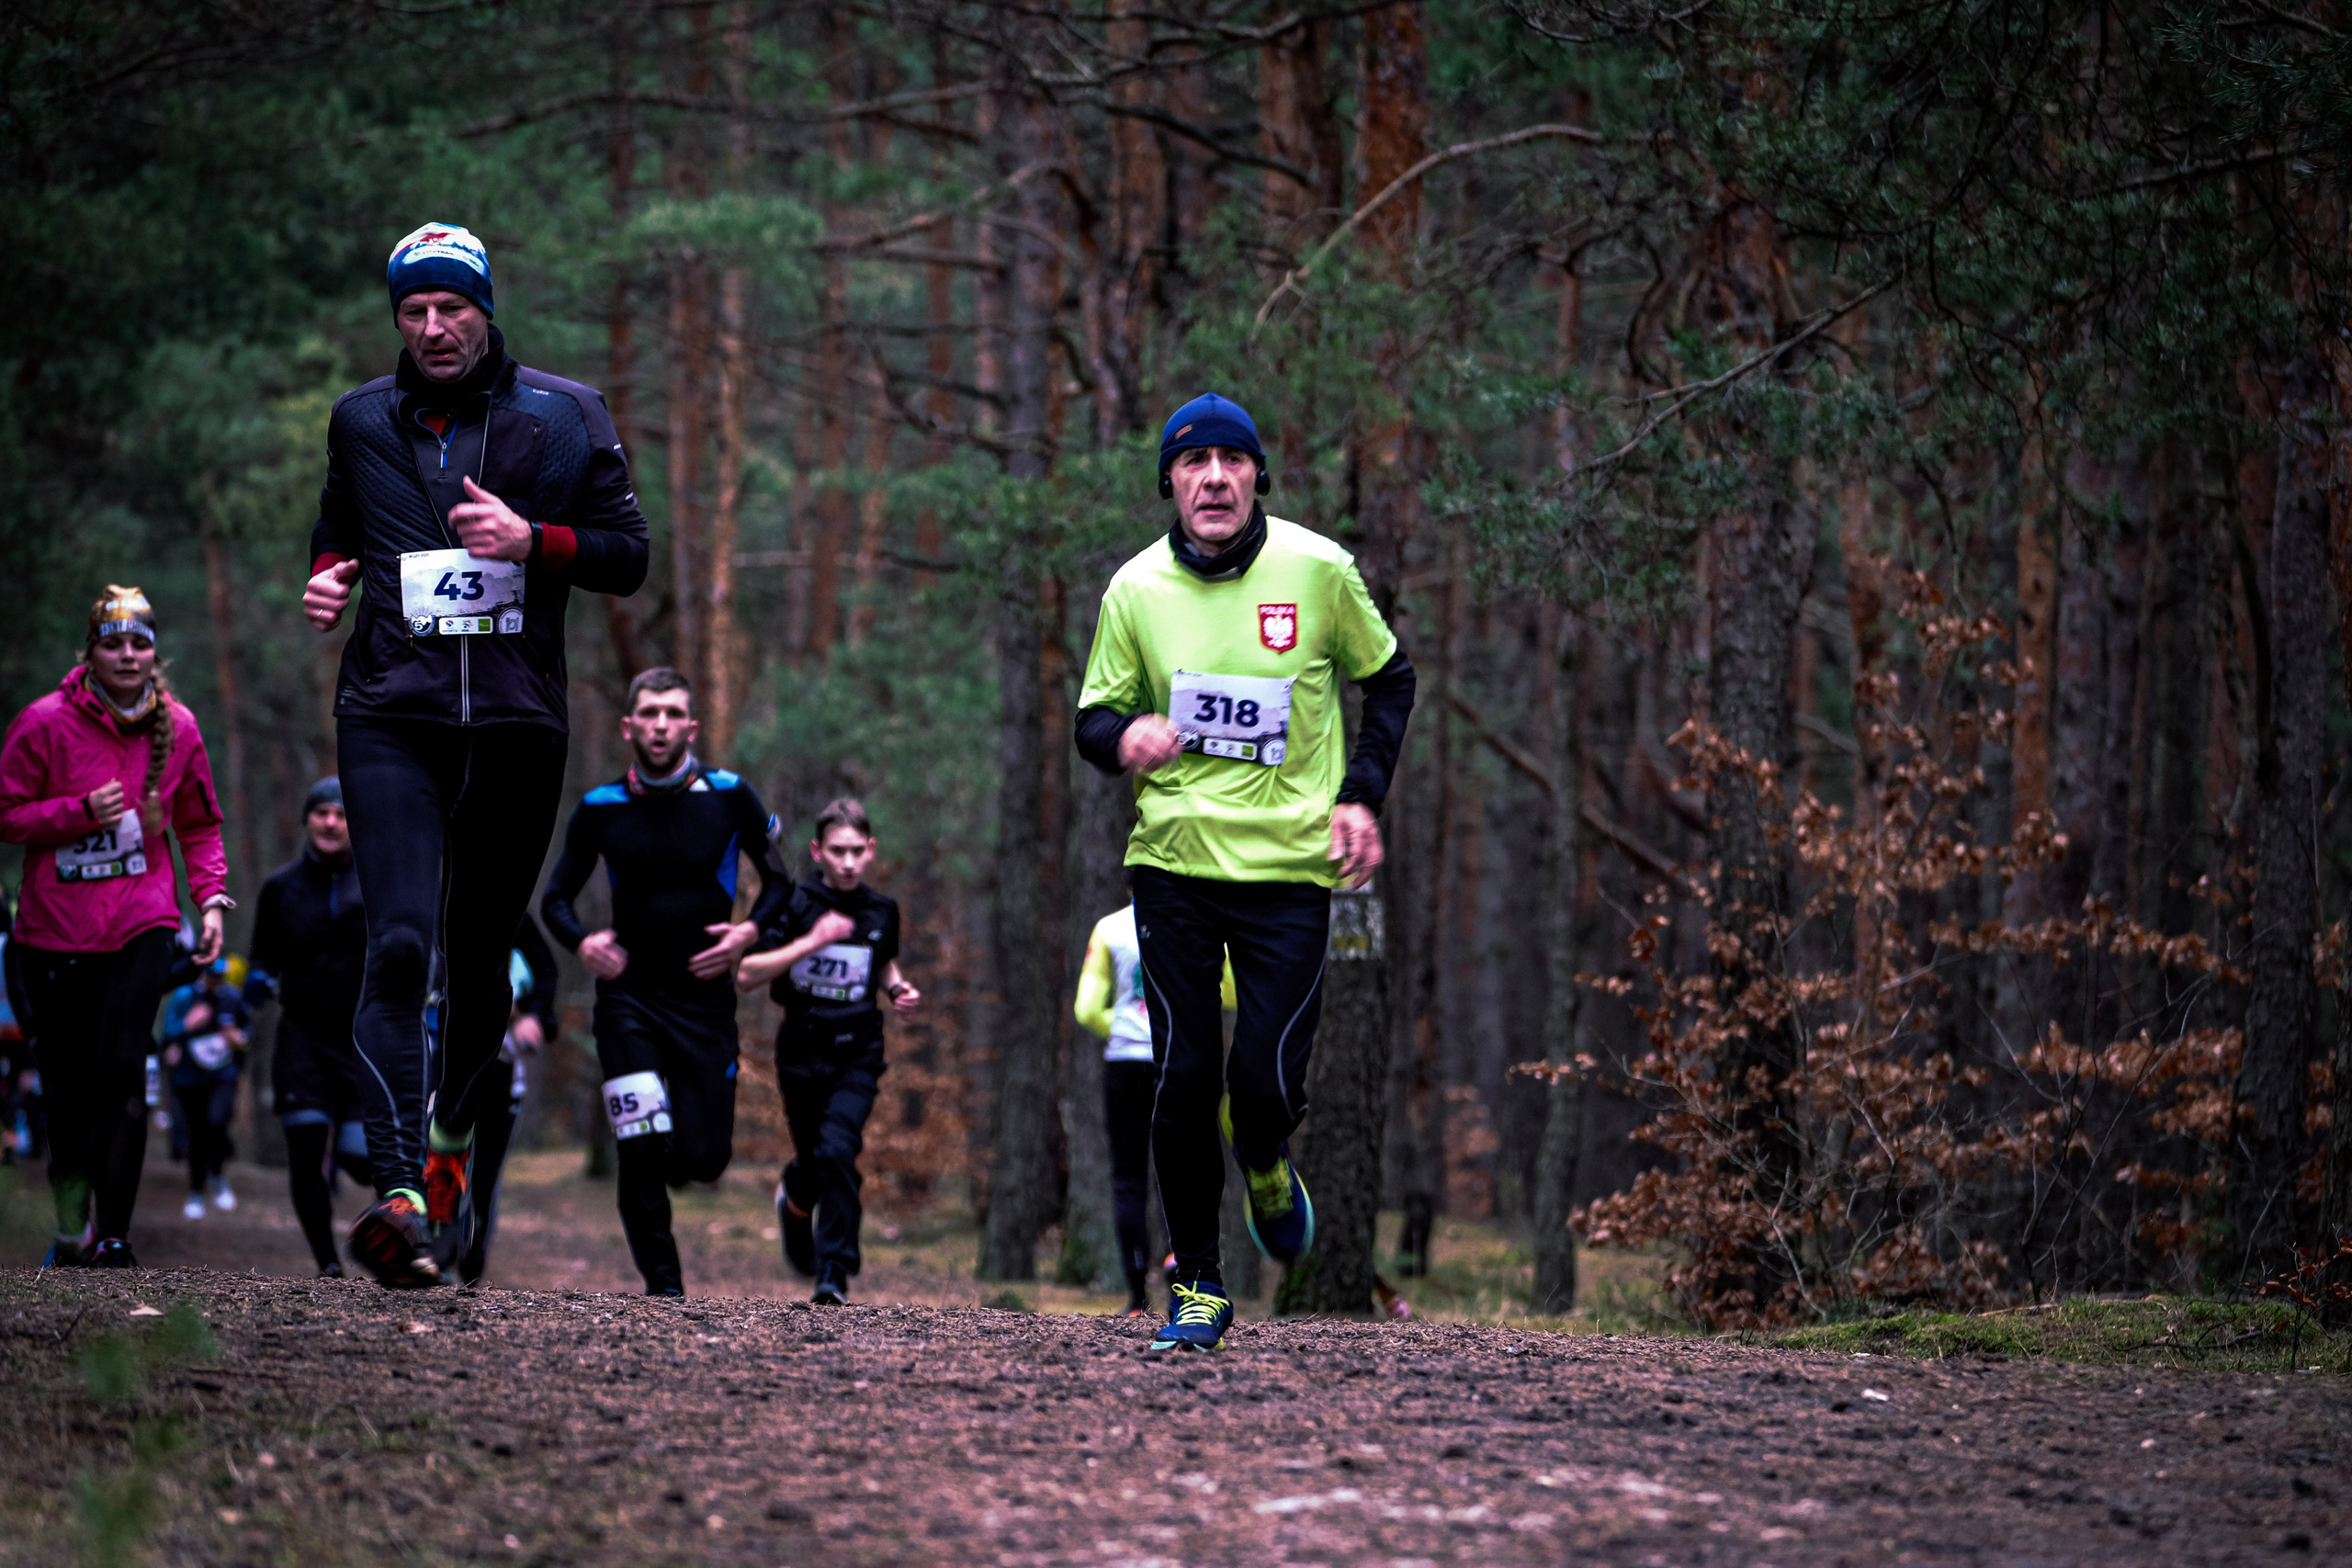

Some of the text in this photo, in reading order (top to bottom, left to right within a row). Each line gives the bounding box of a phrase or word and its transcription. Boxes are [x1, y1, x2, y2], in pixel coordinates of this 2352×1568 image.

[434, 570, 484, 601] 43
[1260, 605, 1295, 615] POLSKA
[1193, 694, 1260, 728] 318
[808, 956, 849, 979] 271
[609, 1092, 639, 1117] 85
